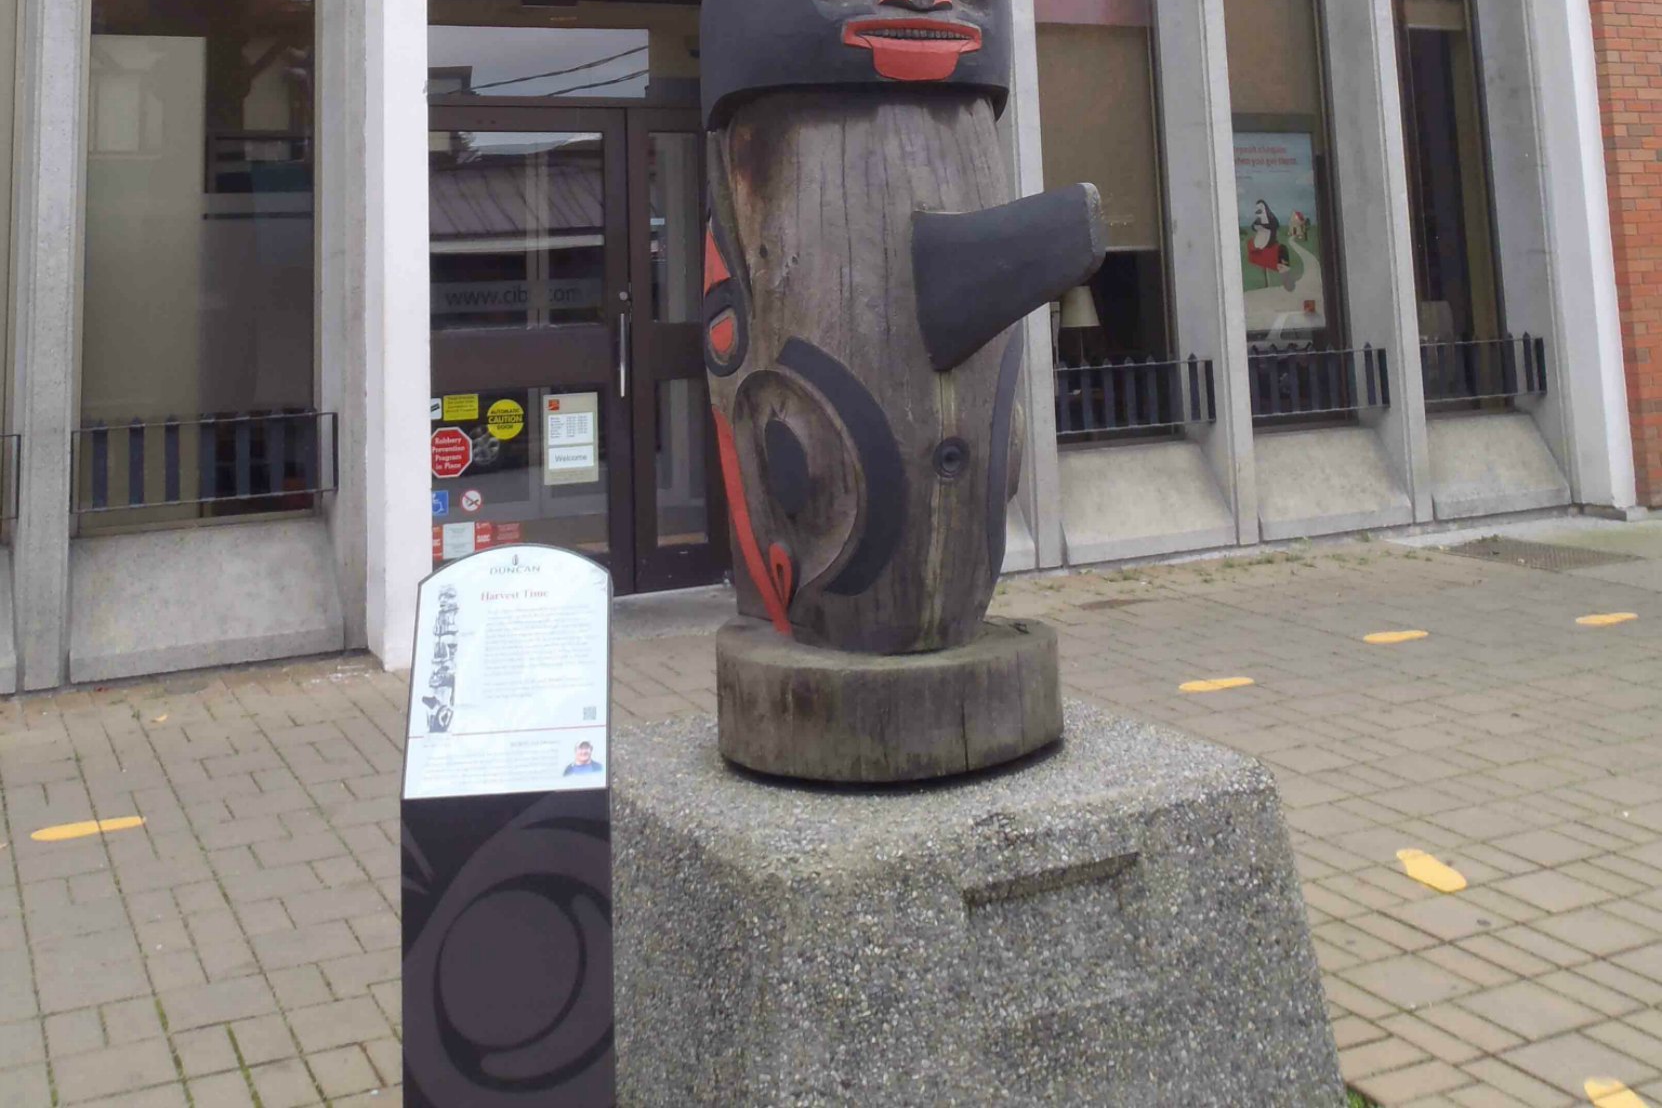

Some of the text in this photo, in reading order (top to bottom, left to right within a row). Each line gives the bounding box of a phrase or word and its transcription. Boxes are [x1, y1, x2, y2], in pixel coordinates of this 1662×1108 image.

[488, 415, 523, 424] CAUTION
[434, 436, 462, 446] Robbery
[554, 453, 588, 463] Welcome
[489, 565, 541, 575] DUNCAN
[480, 589, 550, 601] Harvest Time
